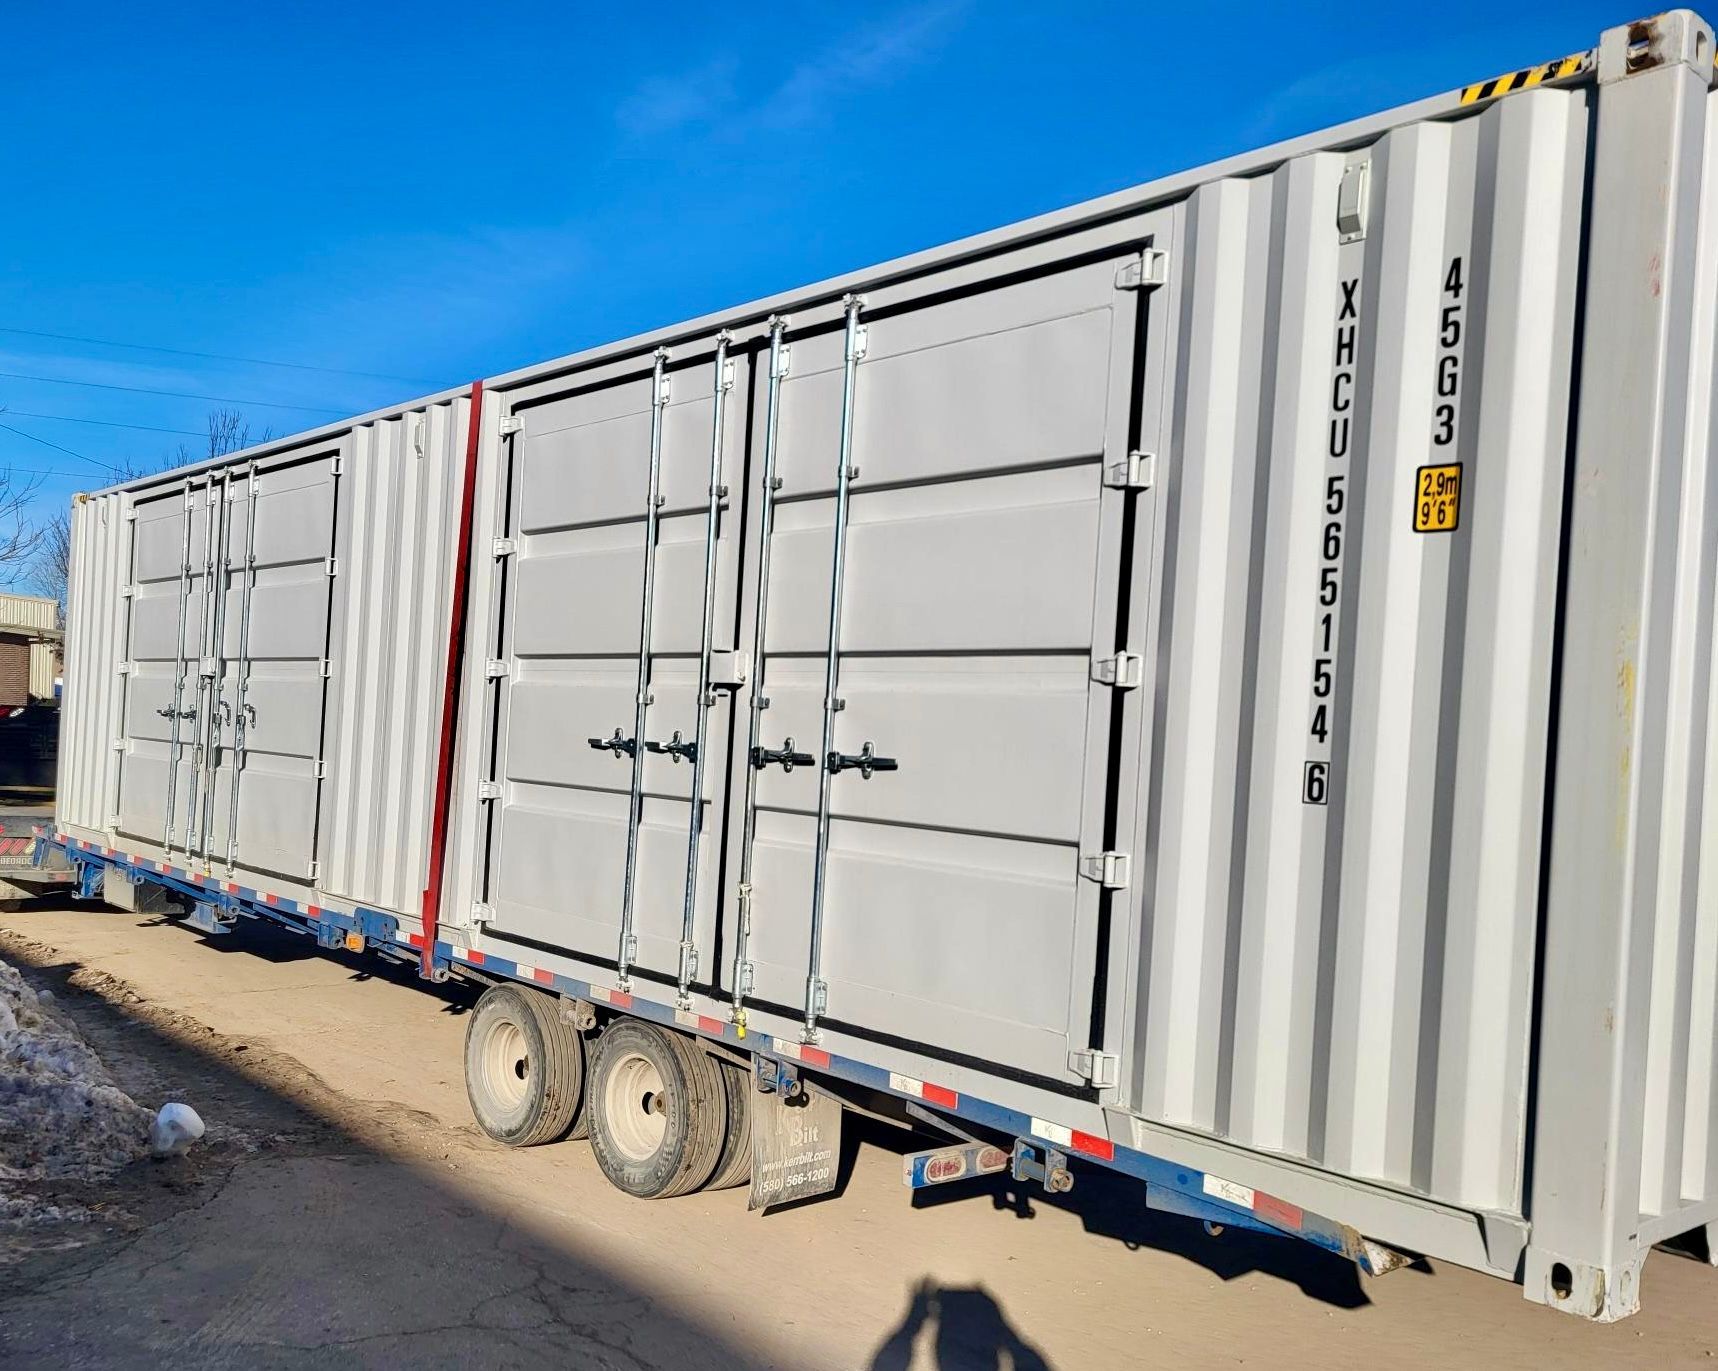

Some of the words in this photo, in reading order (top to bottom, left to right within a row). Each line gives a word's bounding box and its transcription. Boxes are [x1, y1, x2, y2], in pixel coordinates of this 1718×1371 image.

[1329, 278, 1359, 457] XHCU
[1433, 257, 1463, 446] 45G3
[1310, 476, 1345, 744] 565154
[1305, 762, 1327, 804] 6
[0, 857, 33, 865] BEDROC
[759, 1178, 784, 1196] (580)
[786, 1167, 829, 1186] 566-1200
